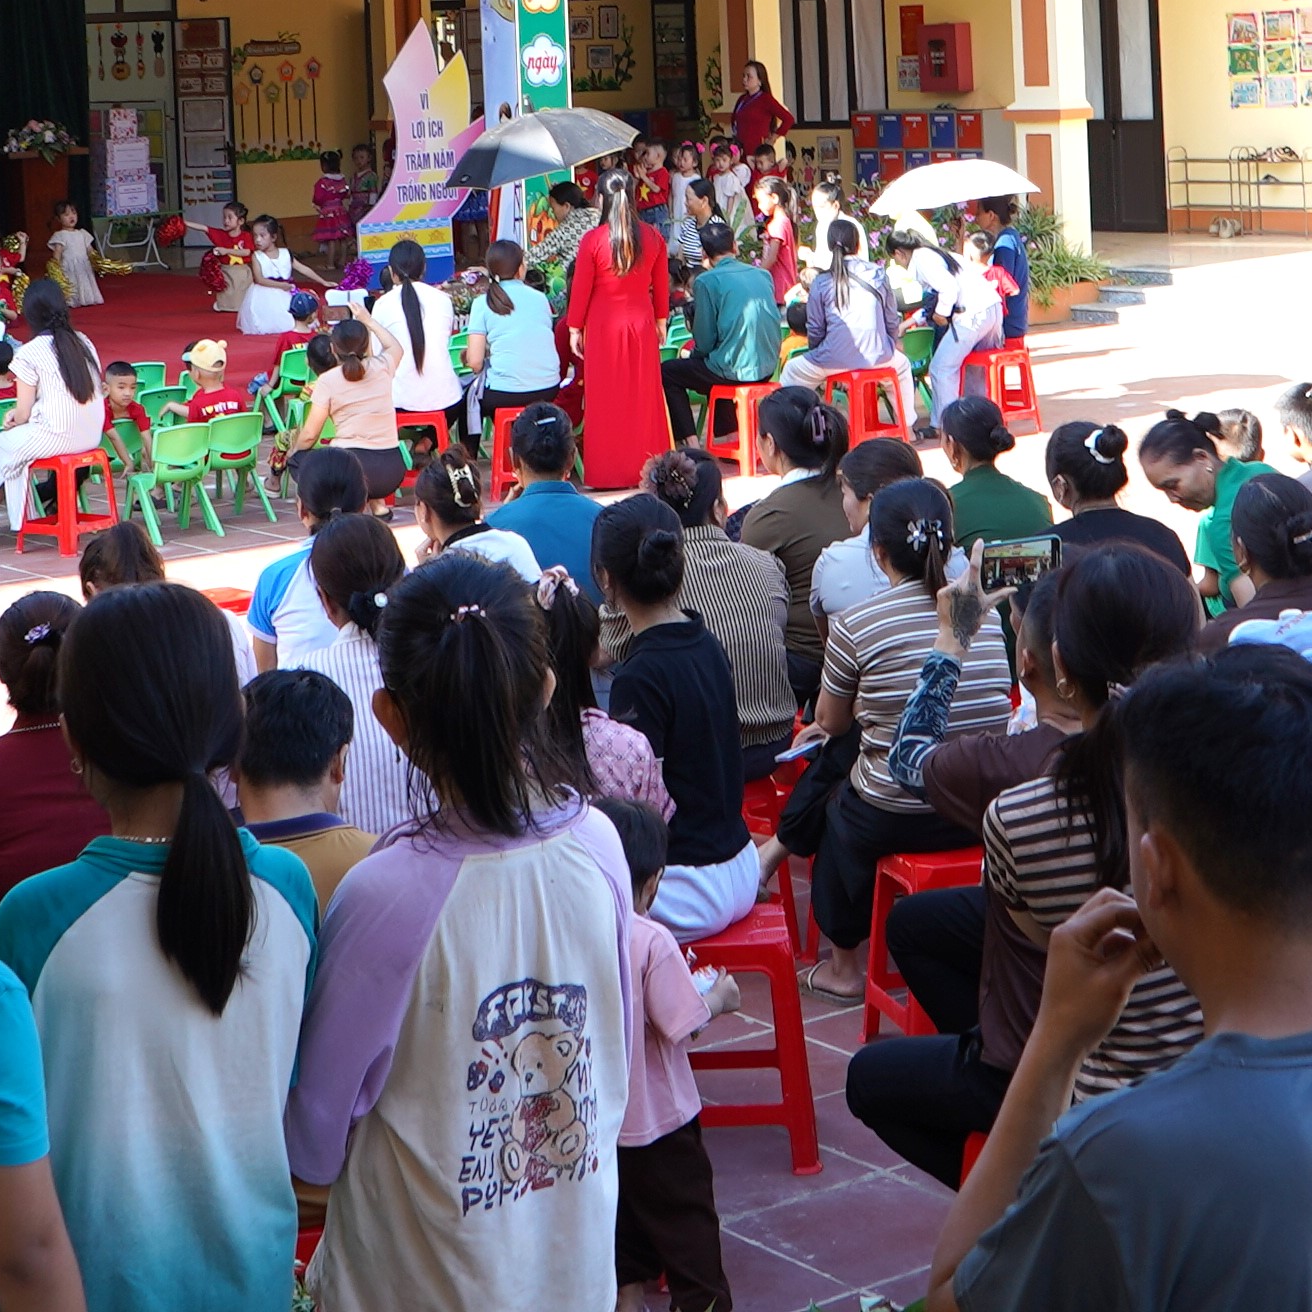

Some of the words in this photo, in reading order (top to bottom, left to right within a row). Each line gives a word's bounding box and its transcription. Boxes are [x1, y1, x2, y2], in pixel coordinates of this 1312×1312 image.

[526, 46, 557, 73] ngày
[419, 89, 430, 110] VÌ
[411, 120, 425, 141] LỢI
[426, 116, 444, 138] ÍCH
[405, 148, 431, 170] TRĂM
[432, 146, 455, 168] NĂM
[396, 179, 426, 203] TRỒNG
